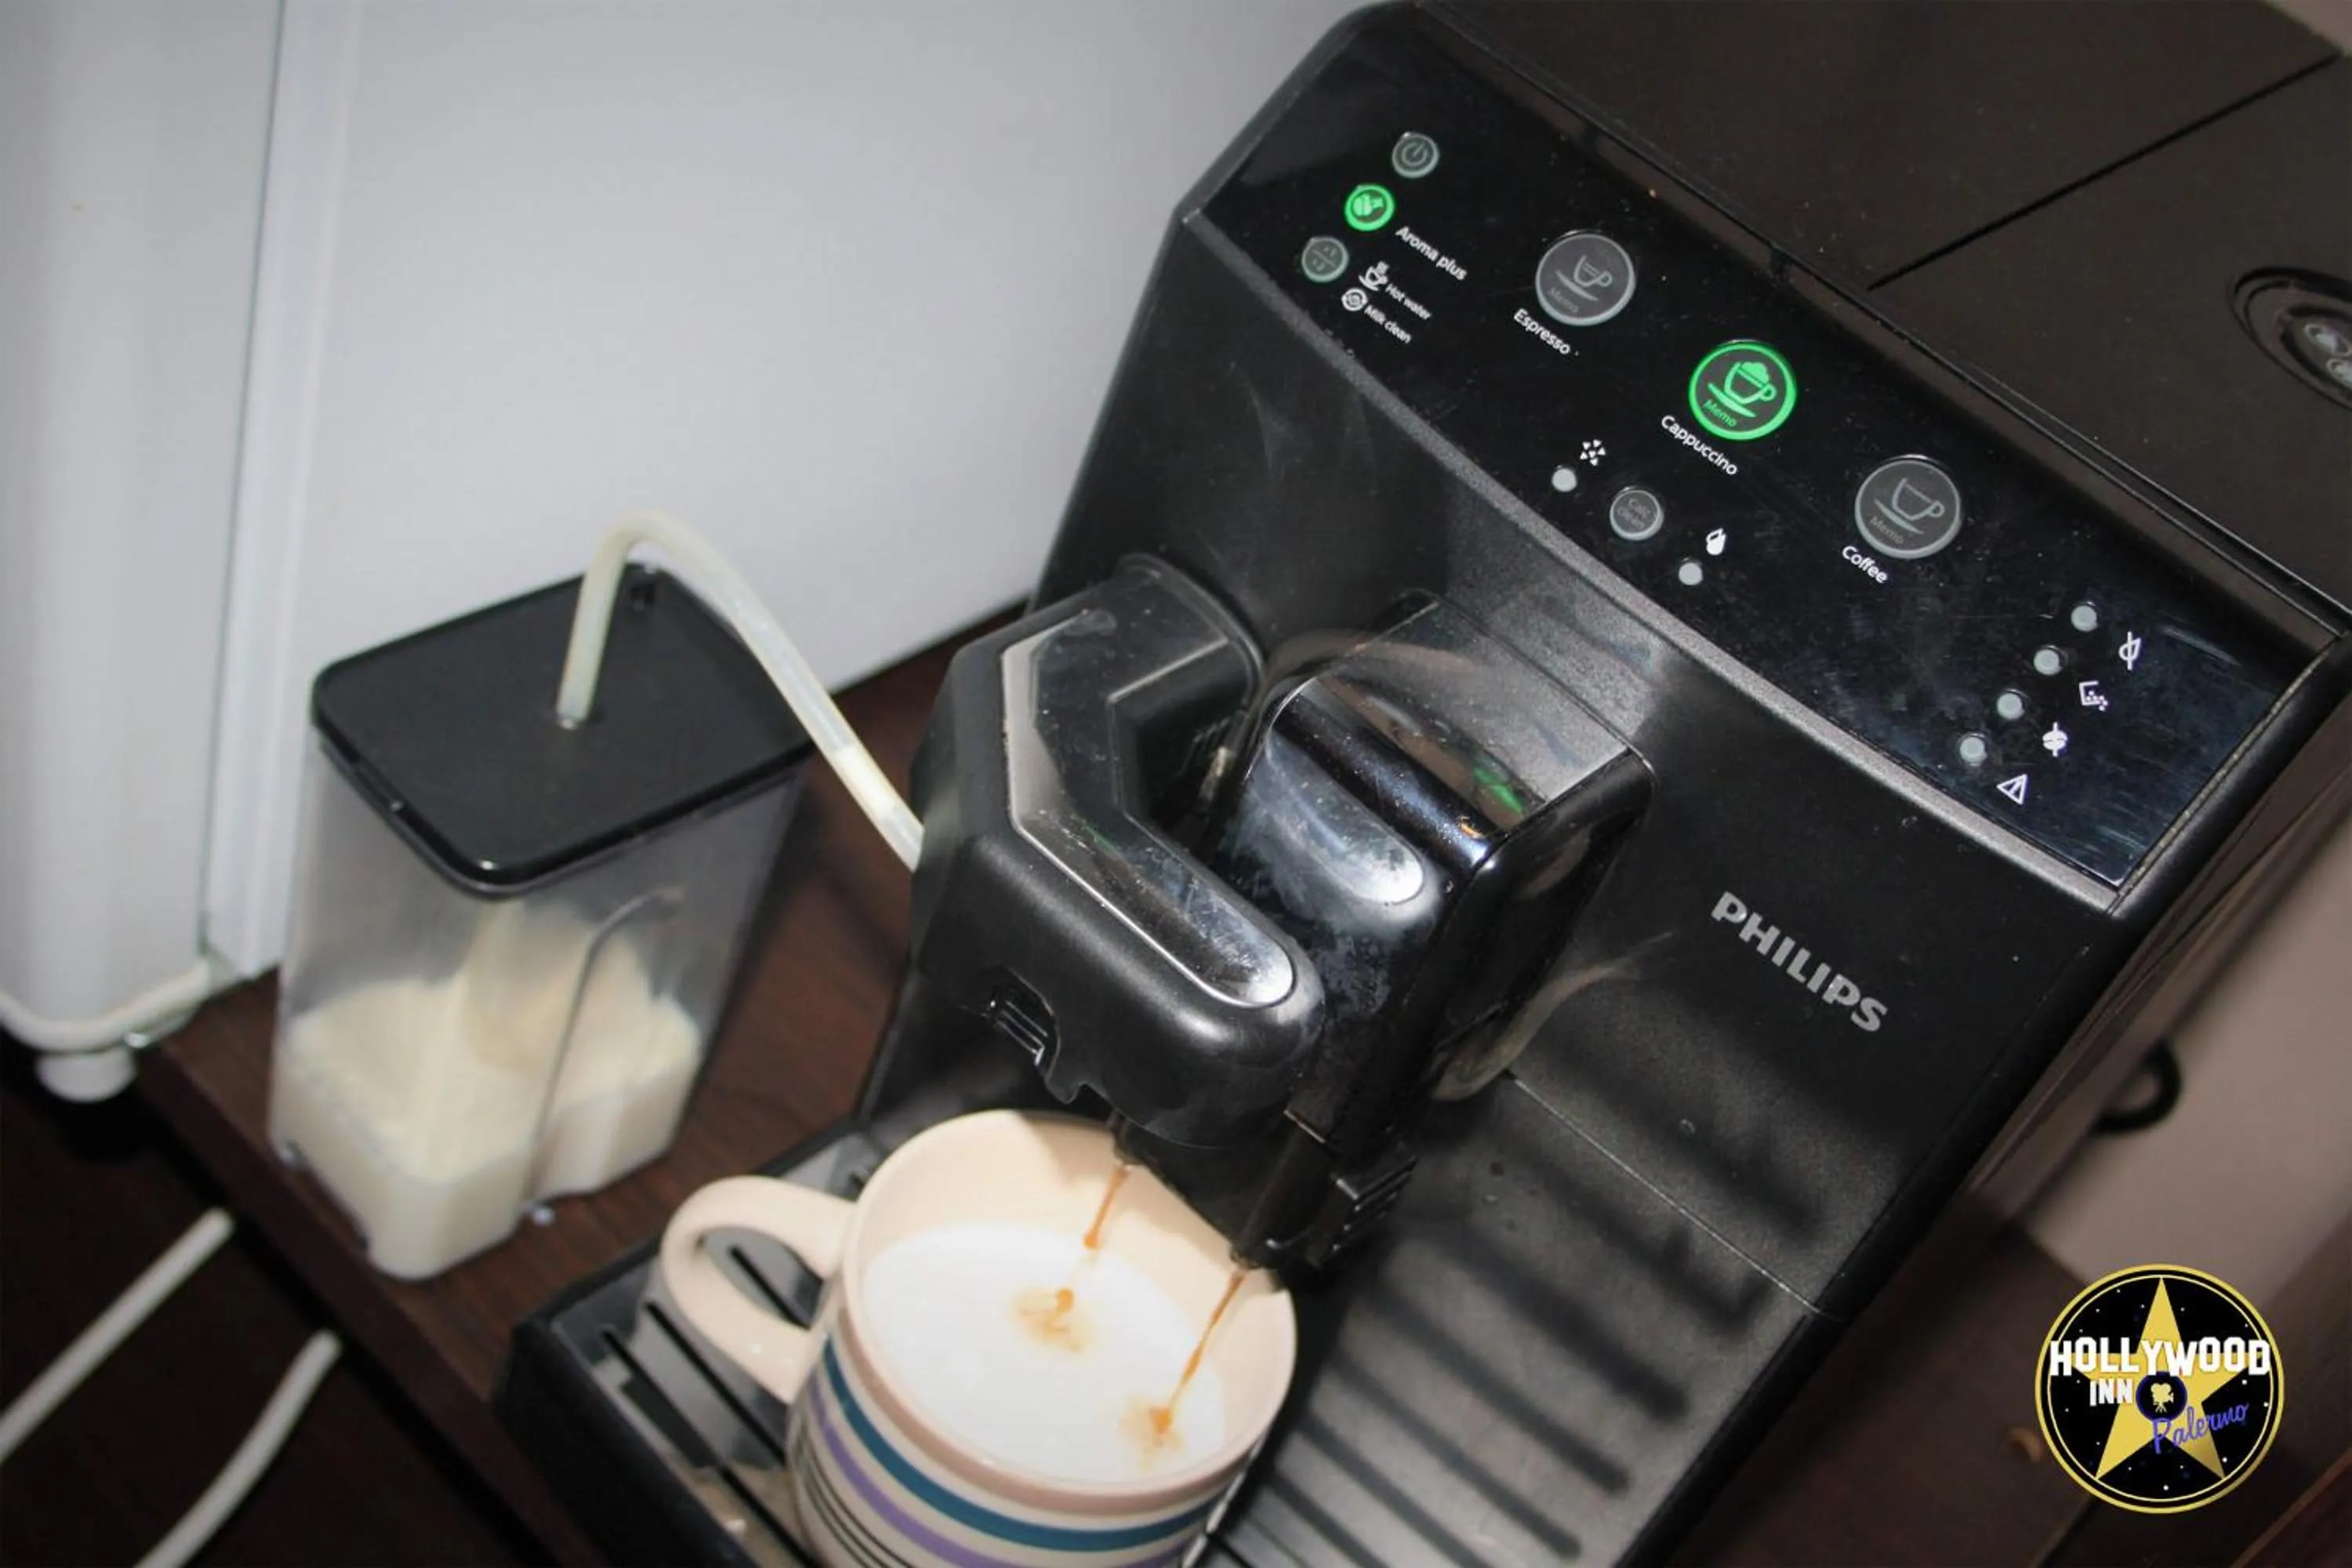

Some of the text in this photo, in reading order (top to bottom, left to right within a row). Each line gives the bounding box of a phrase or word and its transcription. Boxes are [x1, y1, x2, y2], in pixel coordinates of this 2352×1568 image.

[1396, 227, 1467, 280] Aroma plus
[1385, 283, 1432, 320] Hot water
[1363, 304, 1411, 343] Milk clean
[1513, 308, 1570, 355] Espresso
[1704, 399, 1737, 426] Memo
[1661, 415, 1738, 475] Cappuccino
[1868, 516, 1904, 544] Memo
[1842, 545, 1888, 584] Coffee
[1711, 891, 1888, 1032] PHILIPS
